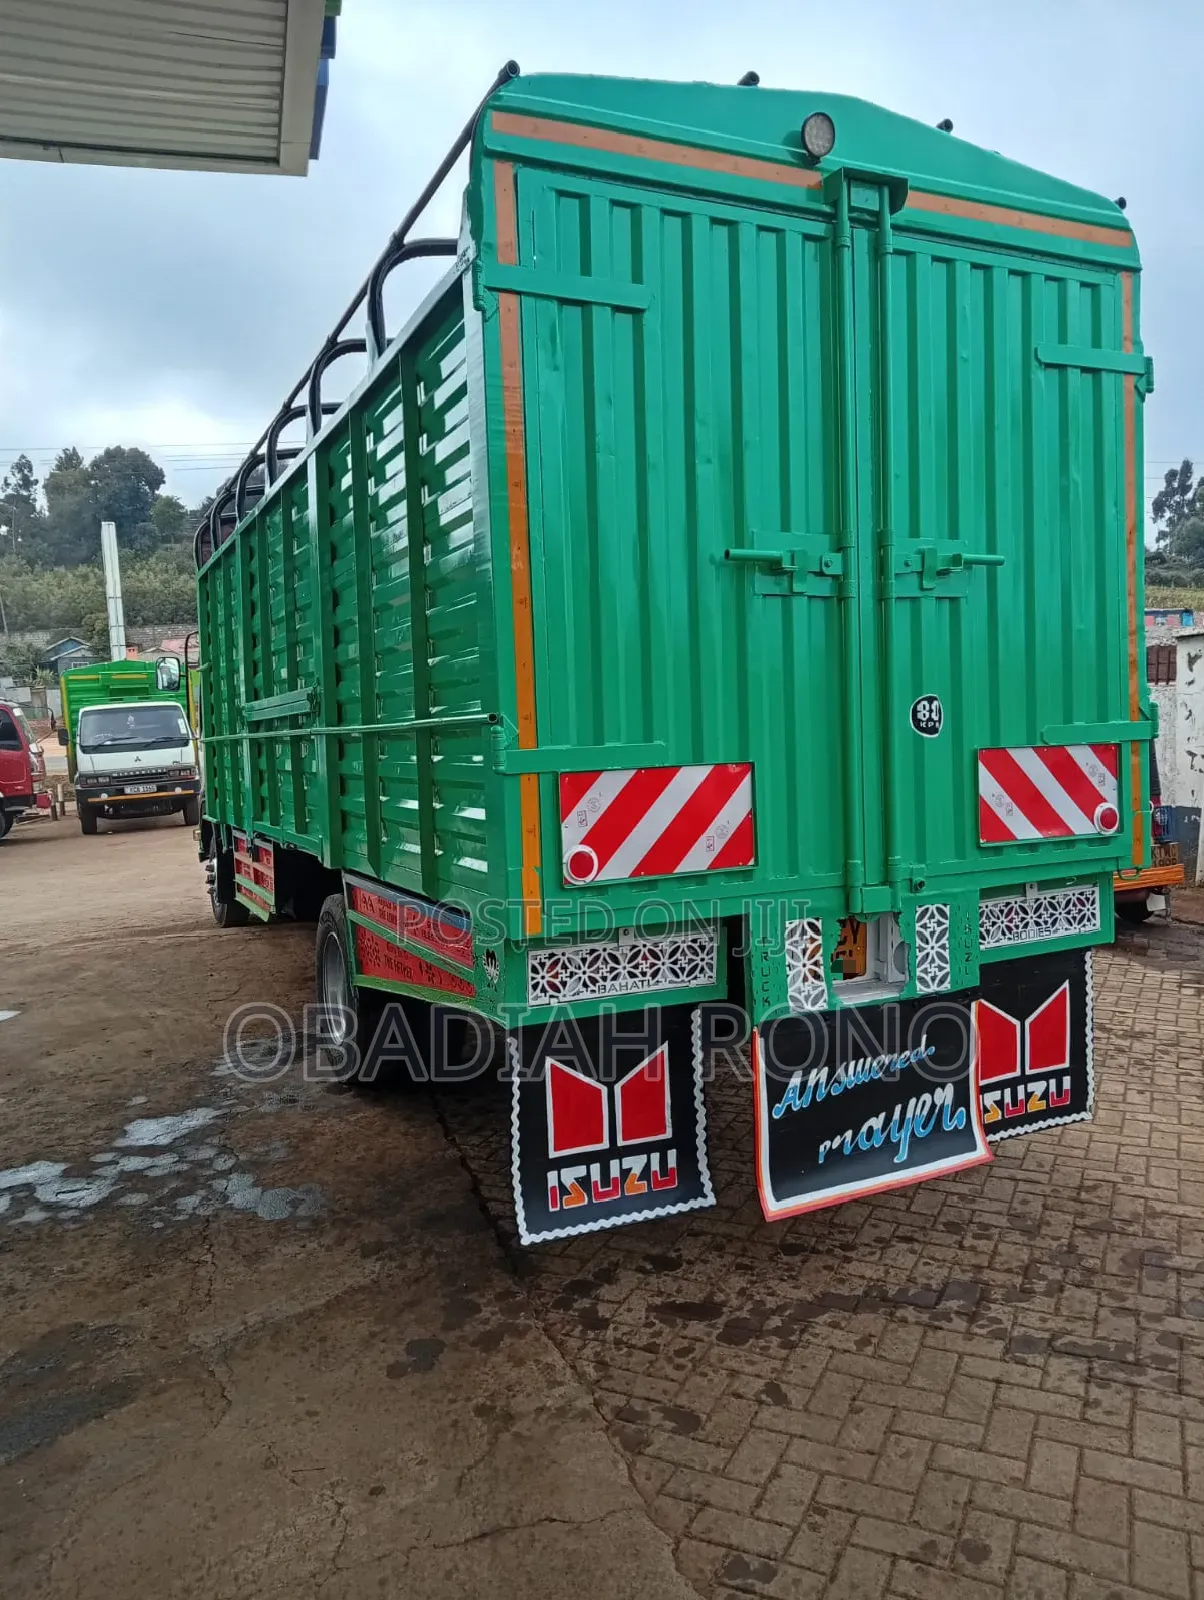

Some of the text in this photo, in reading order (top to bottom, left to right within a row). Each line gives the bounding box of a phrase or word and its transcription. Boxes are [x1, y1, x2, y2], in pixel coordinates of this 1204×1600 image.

[1012, 927, 1052, 942] BODIES
[597, 978, 654, 995] BAHATI
[547, 1149, 678, 1212] ISUZU
